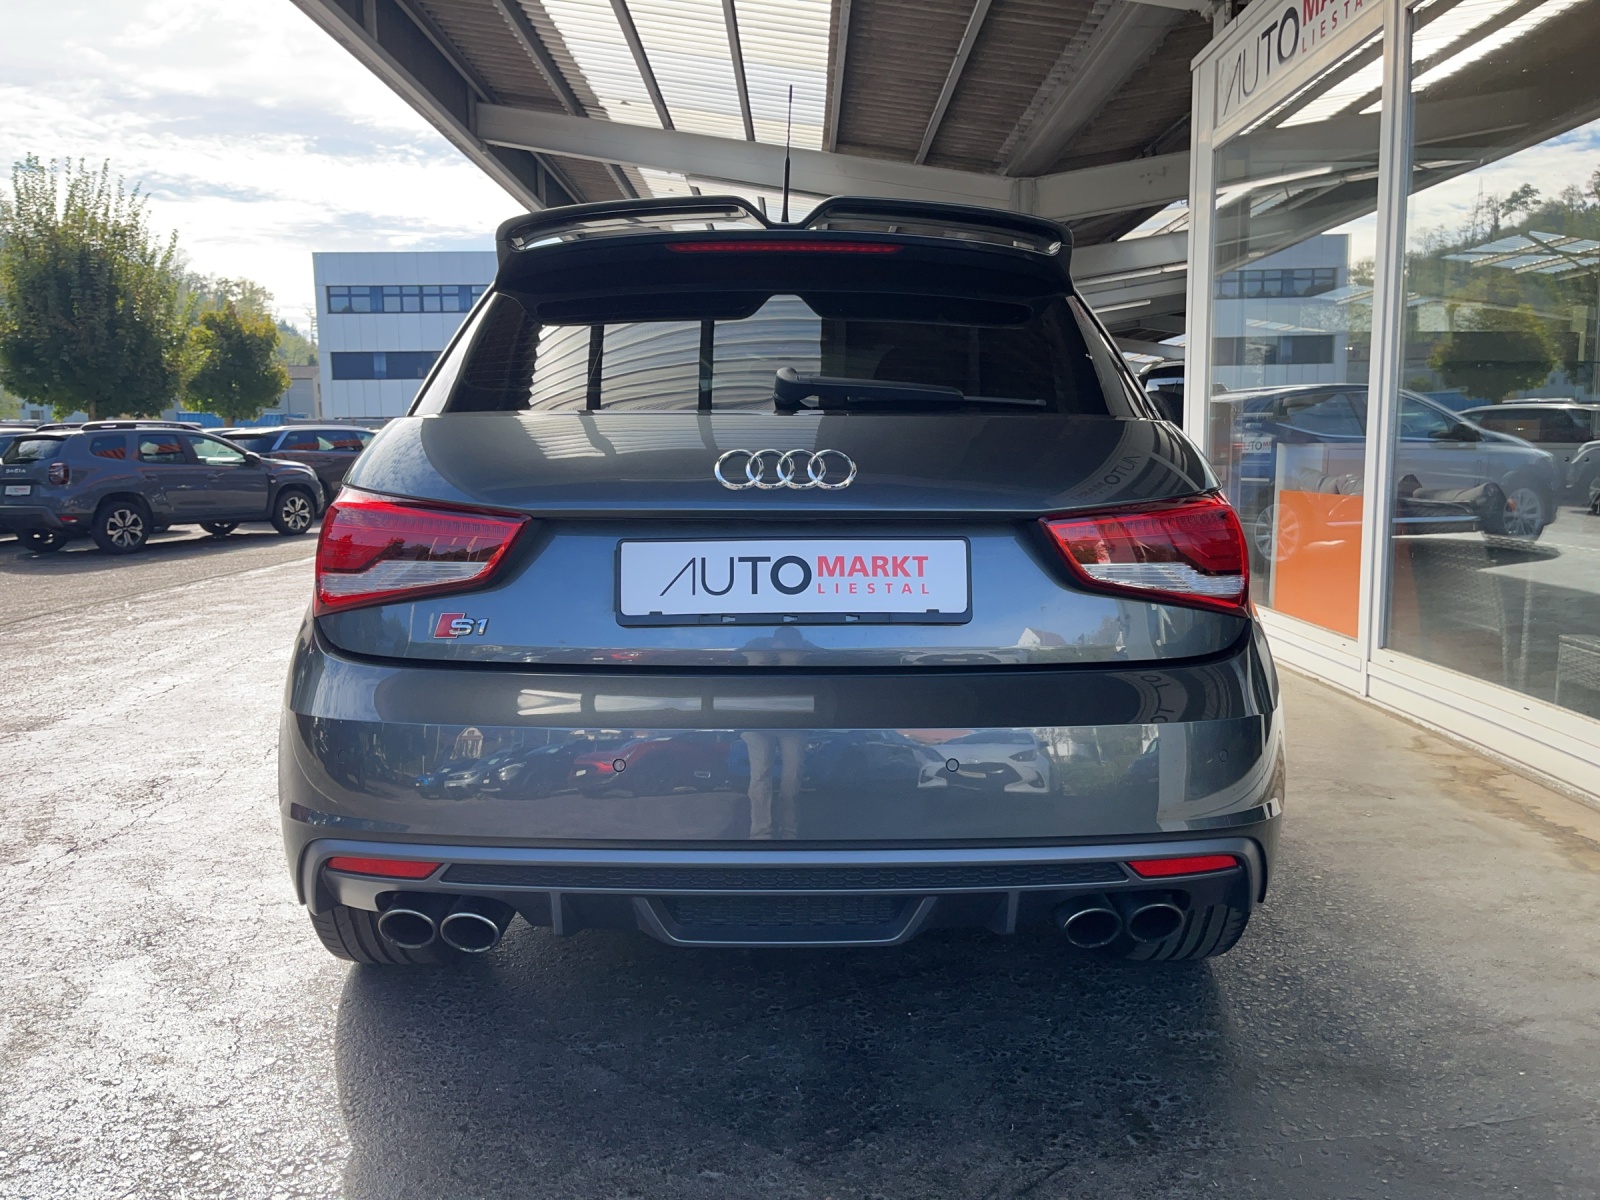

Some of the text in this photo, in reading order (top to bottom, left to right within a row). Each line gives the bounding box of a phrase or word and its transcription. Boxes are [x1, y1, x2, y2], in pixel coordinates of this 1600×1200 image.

[1223, 6, 1300, 116] AUTO
[659, 555, 929, 597] AUTO MARKT
[817, 583, 930, 595] LIESTAL
[448, 618, 489, 636] S1
